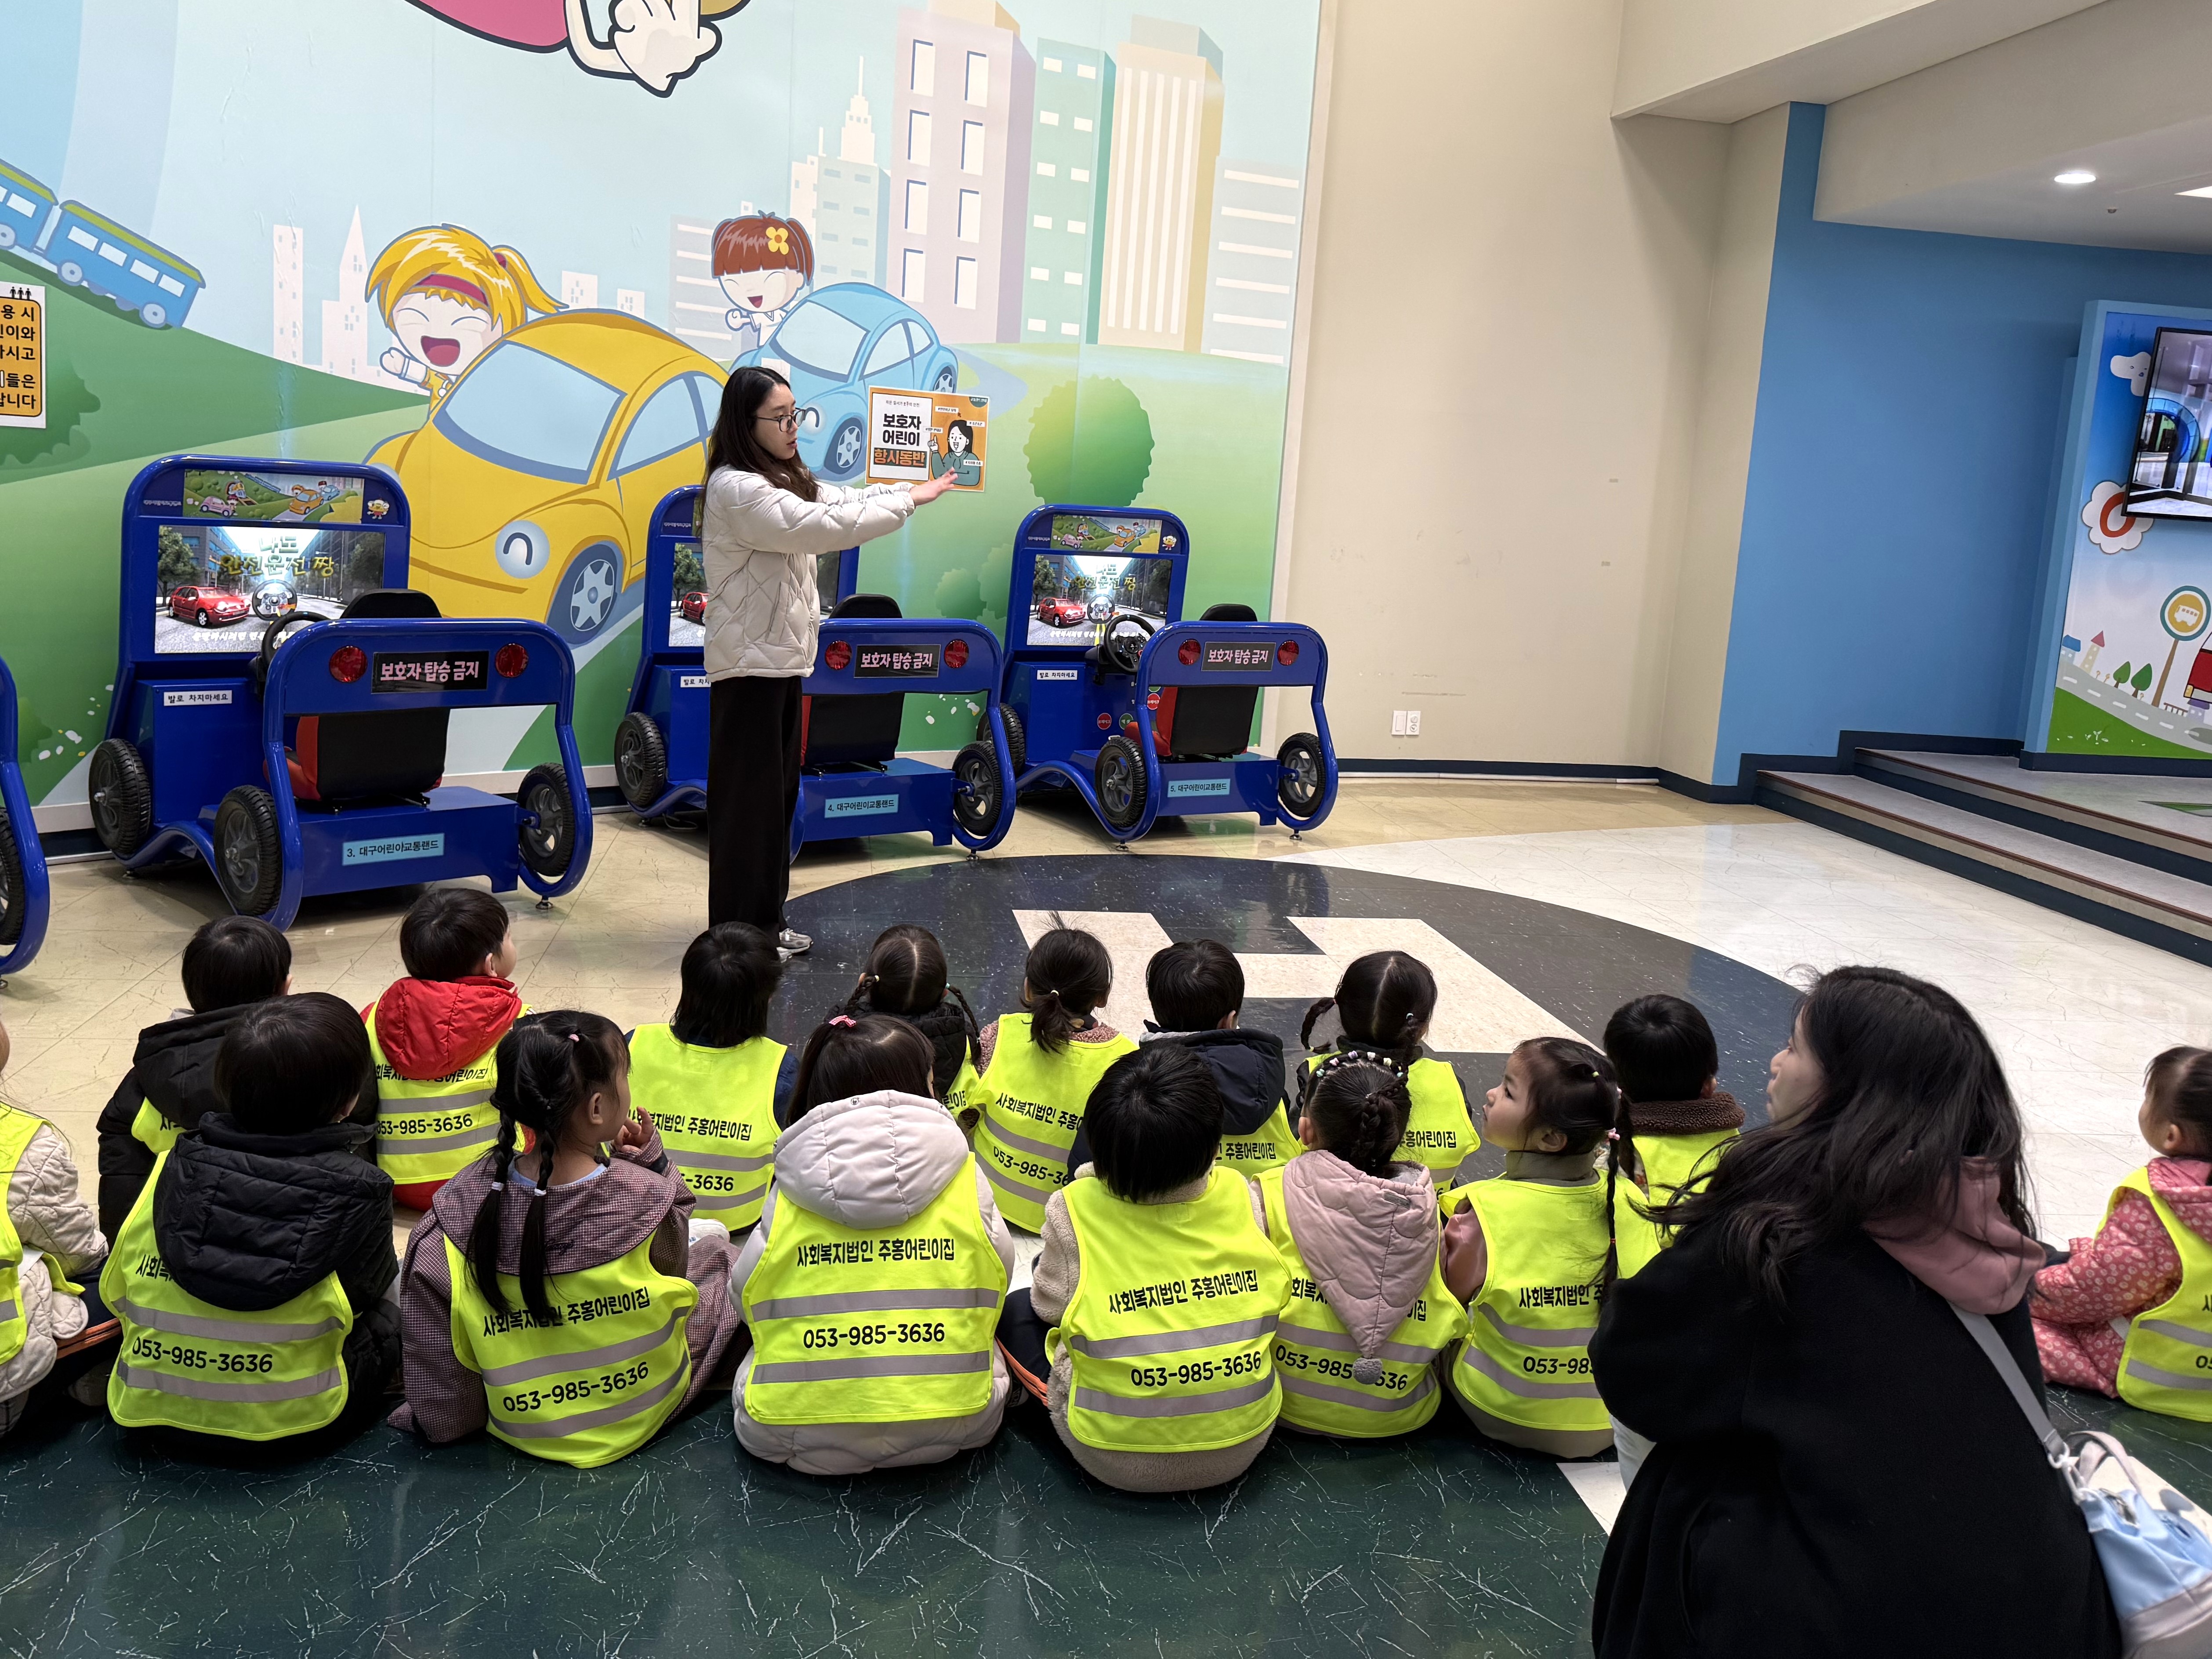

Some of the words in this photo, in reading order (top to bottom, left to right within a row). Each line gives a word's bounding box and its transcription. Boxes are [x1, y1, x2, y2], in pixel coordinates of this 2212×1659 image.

[21, 307, 34, 321] 시
[883, 414, 921, 430] 보호자
[883, 430, 920, 446] 어린이
[874, 449, 925, 466] 항시동반
[861, 652, 891, 668] 보호자
[892, 652, 911, 670] 탑승
[913, 653, 932, 669] 금지
[1208, 649, 1233, 662] 보호자
[1235, 649, 1251, 664] 탑승
[1252, 650, 1269, 664] 금지
[381, 661, 421, 681] 보호자
[424, 661, 451, 682] 탑승
[453, 661, 479, 680] 금지
[168, 695, 184, 703] 발로
[189, 693, 228, 702] 차지마세요
[837, 800, 894, 811] 대구어린이교통랜드
[347, 848, 355, 857] 3.
[359, 840, 439, 856] 대구어린이교통랜드
[996, 1093, 1056, 1124] 사회복지법인
[687, 1117, 752, 1141] 주홍어린이집
[1226, 1142, 1276, 1160] 주홍어린이집
[798, 1240, 873, 1267] 사회복지법인
[878, 1238, 954, 1262] 주홍어린이집
[1110, 1280, 1188, 1314] 사회복지법인
[1190, 1269, 1258, 1300] 주홍어린이집
[1519, 1285, 1589, 1308] 사회복지법인
[567, 1286, 650, 1325] 주홍어린이집
[804, 1323, 945, 1348] 053-985-3636
[132, 1336, 273, 1373] 053-985-3636
[1131, 1351, 1261, 1387] 053-985-3636
[503, 1362, 649, 1412] 053-985-3636
